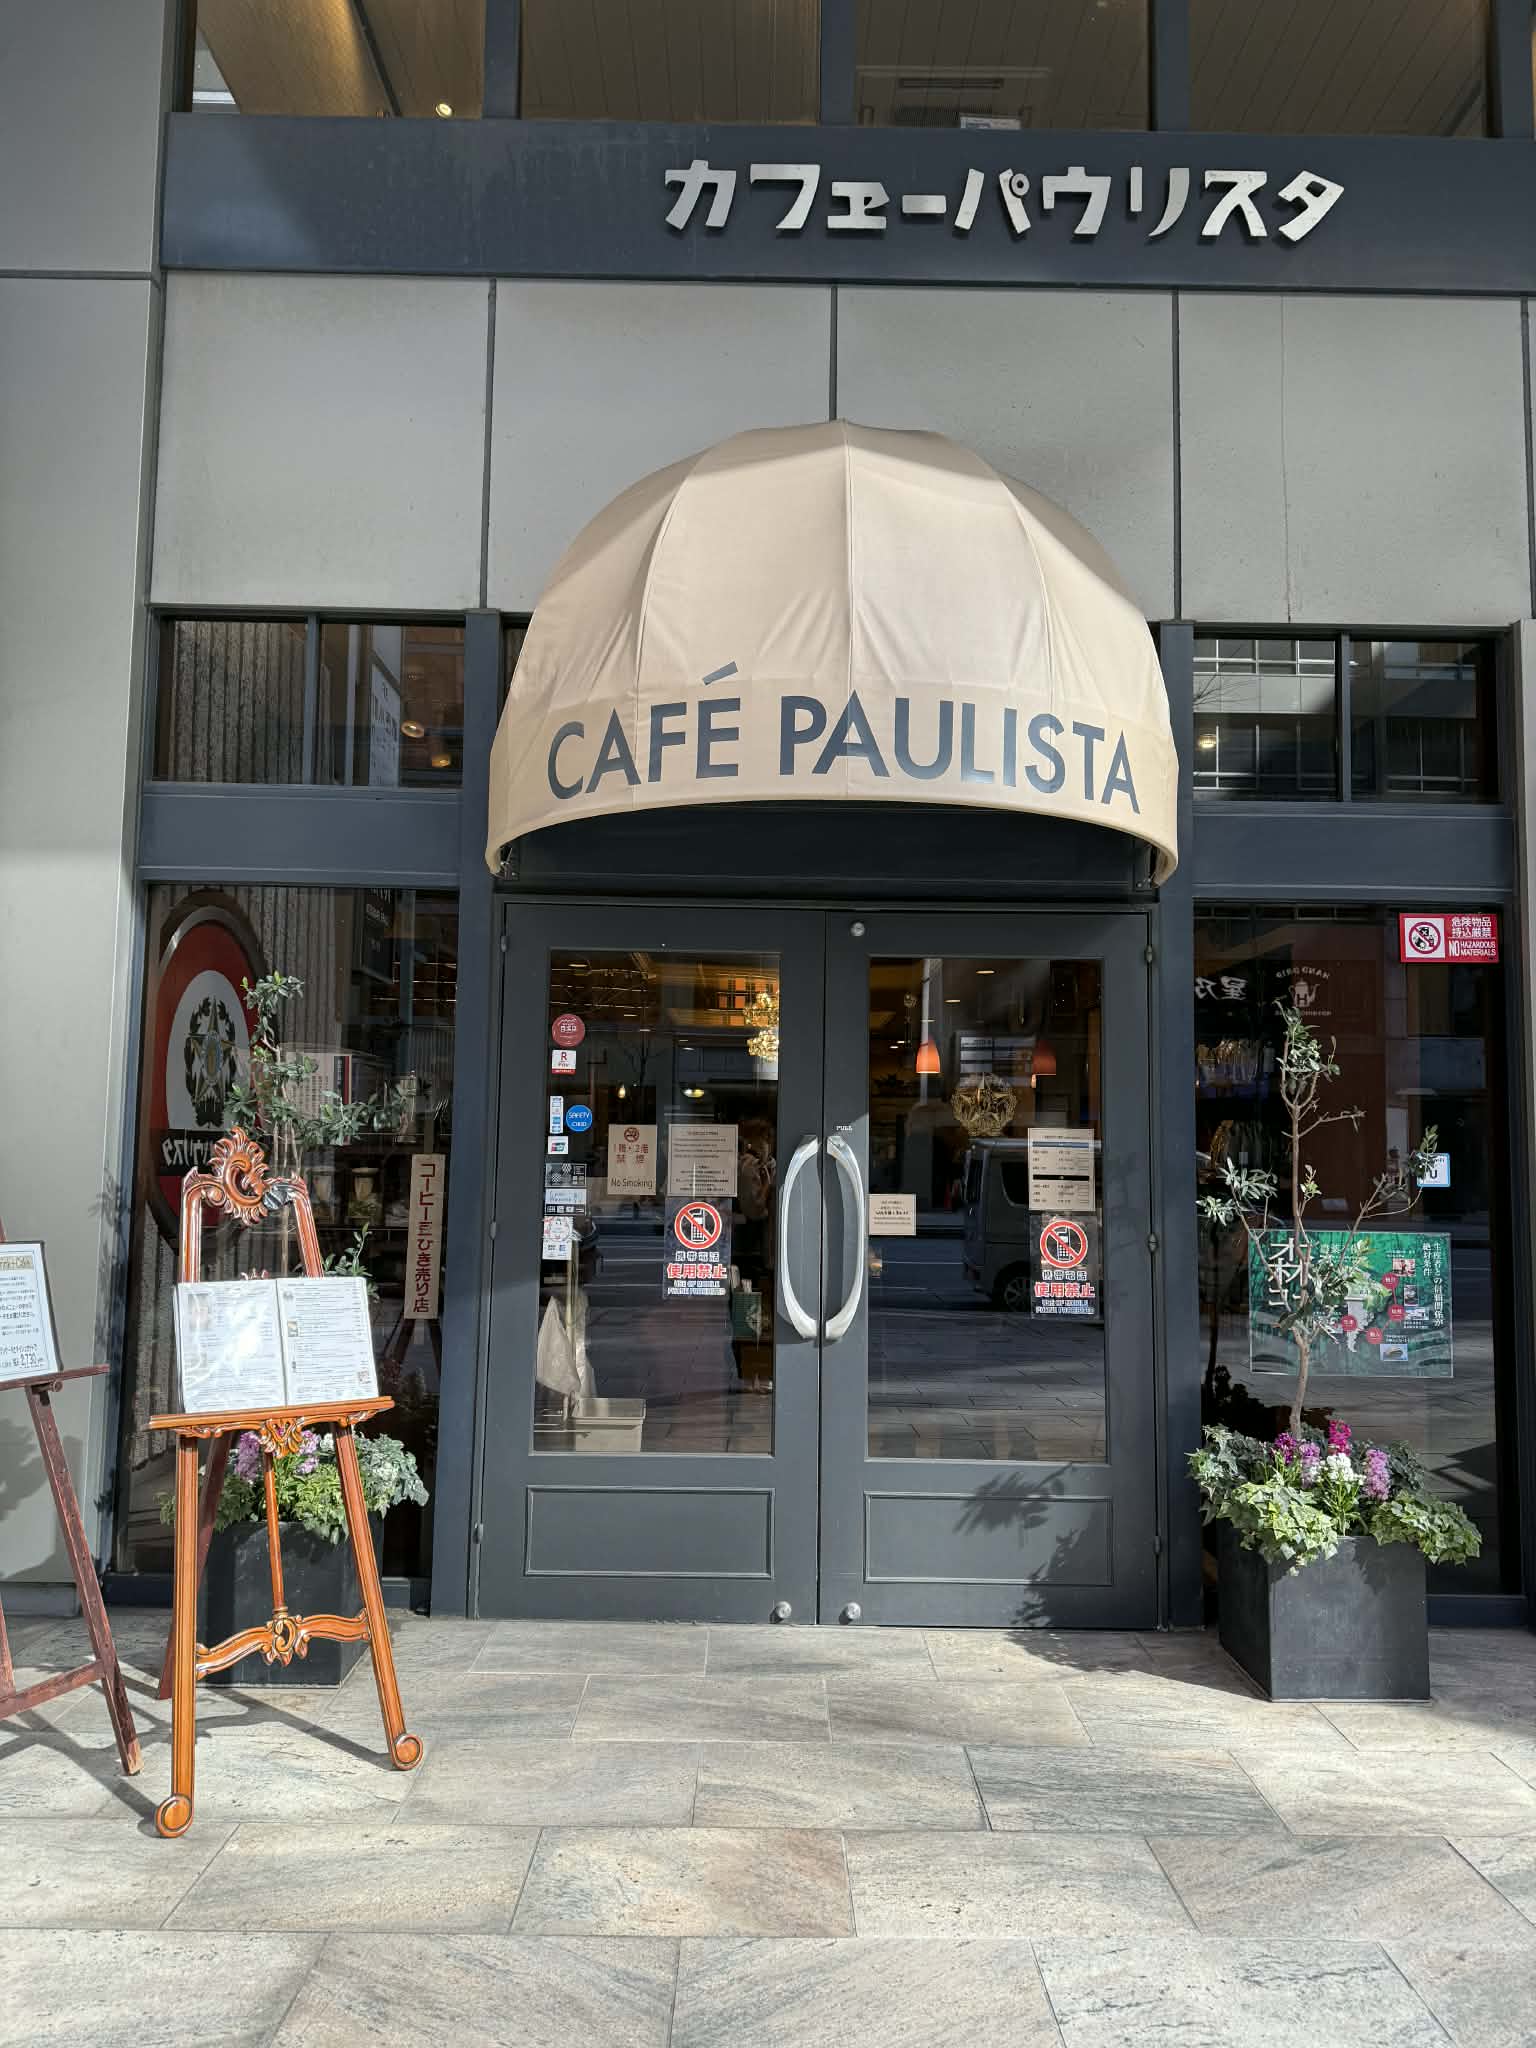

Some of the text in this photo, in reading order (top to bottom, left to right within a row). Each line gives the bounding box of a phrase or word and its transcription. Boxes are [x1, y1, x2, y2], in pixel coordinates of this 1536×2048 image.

[665, 160, 1344, 242] カフヱーパウリスタ
[547, 661, 741, 799] CAFÉ
[779, 690, 1140, 814] PAULISTA
[1449, 941, 1496, 956] NO HAZARDOUS
[611, 1178, 653, 1189] No Smoking
[667, 1263, 727, 1279] 使用禁止
[1034, 1282, 1095, 1297] 使用禁止
